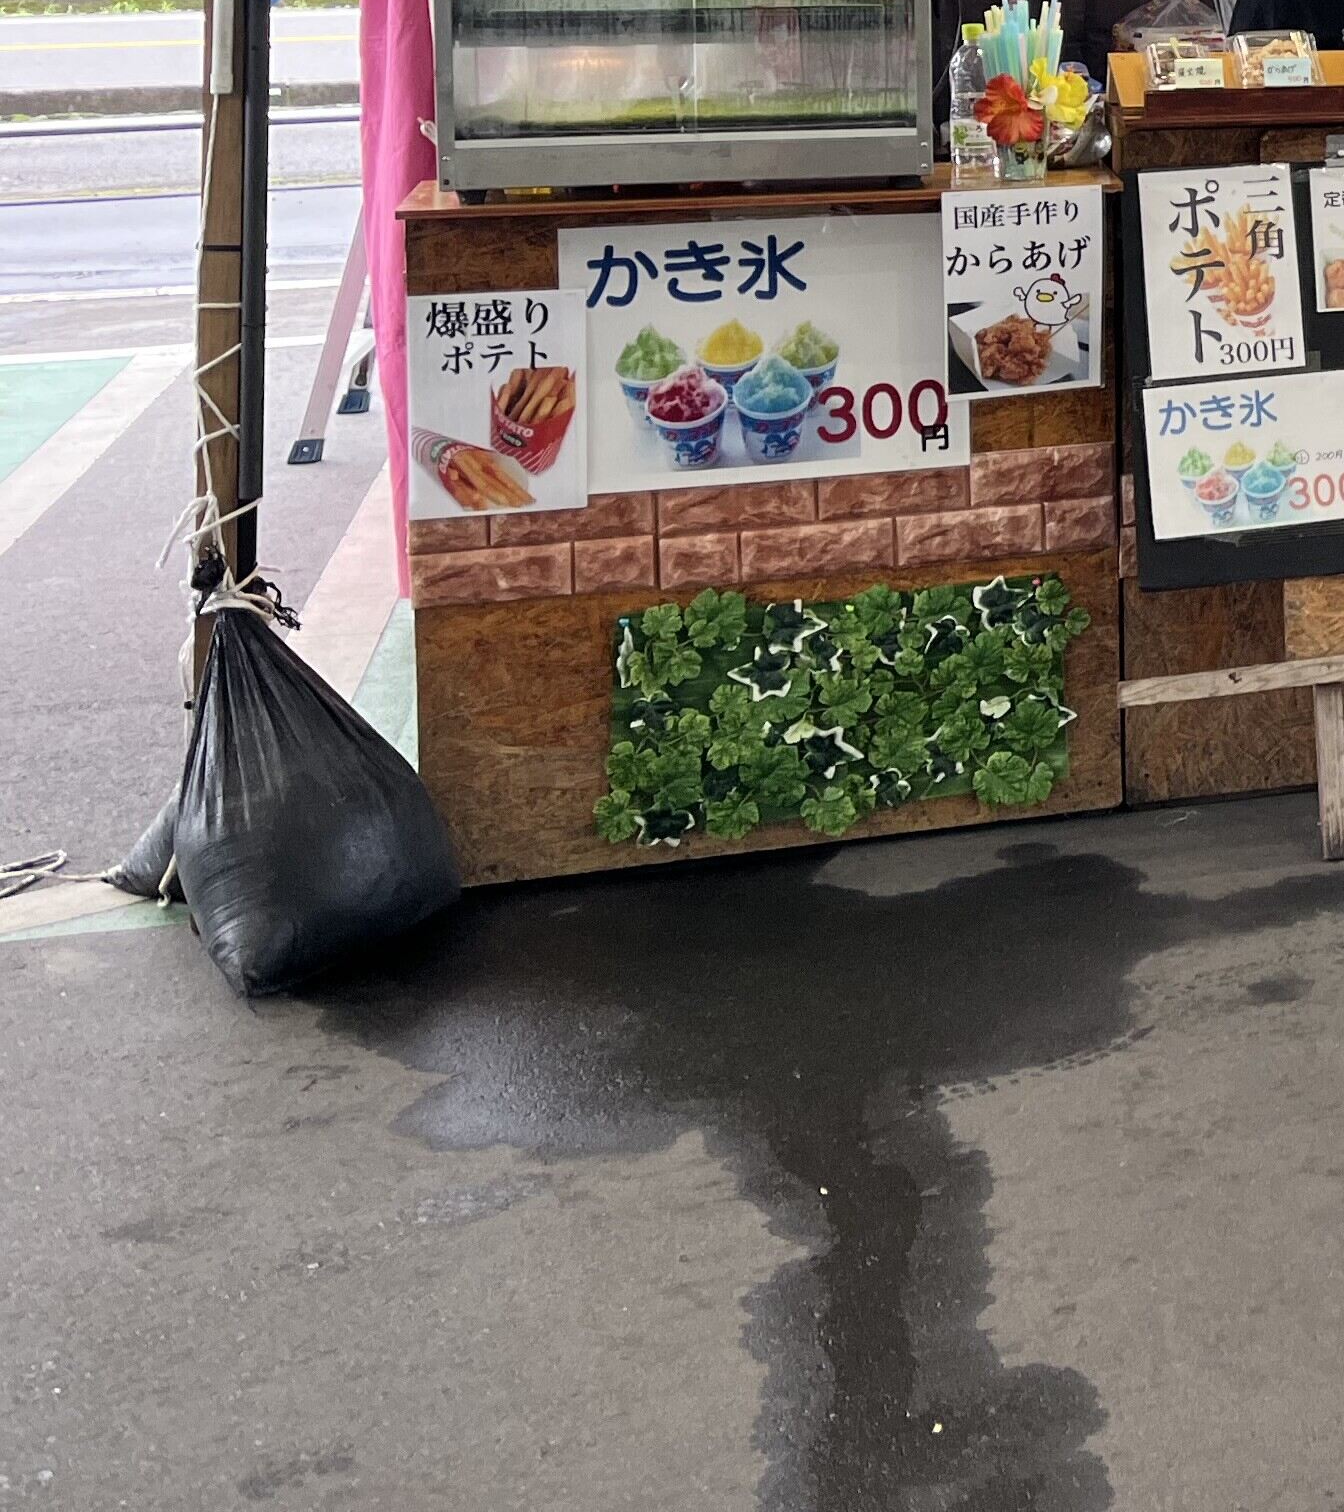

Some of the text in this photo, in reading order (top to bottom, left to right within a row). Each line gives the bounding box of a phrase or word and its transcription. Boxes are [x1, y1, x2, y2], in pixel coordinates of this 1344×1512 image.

[954, 199, 1079, 230] 国産手作り
[1243, 175, 1285, 263] 三角
[586, 235, 807, 308] かき氷
[946, 235, 1091, 277] からあげ
[1169, 179, 1226, 365] ポテト
[425, 297, 550, 340] 爆盛り
[442, 338, 550, 375] ポテト
[1219, 337, 1295, 366] 300円
[1159, 389, 1278, 437] かき氷
